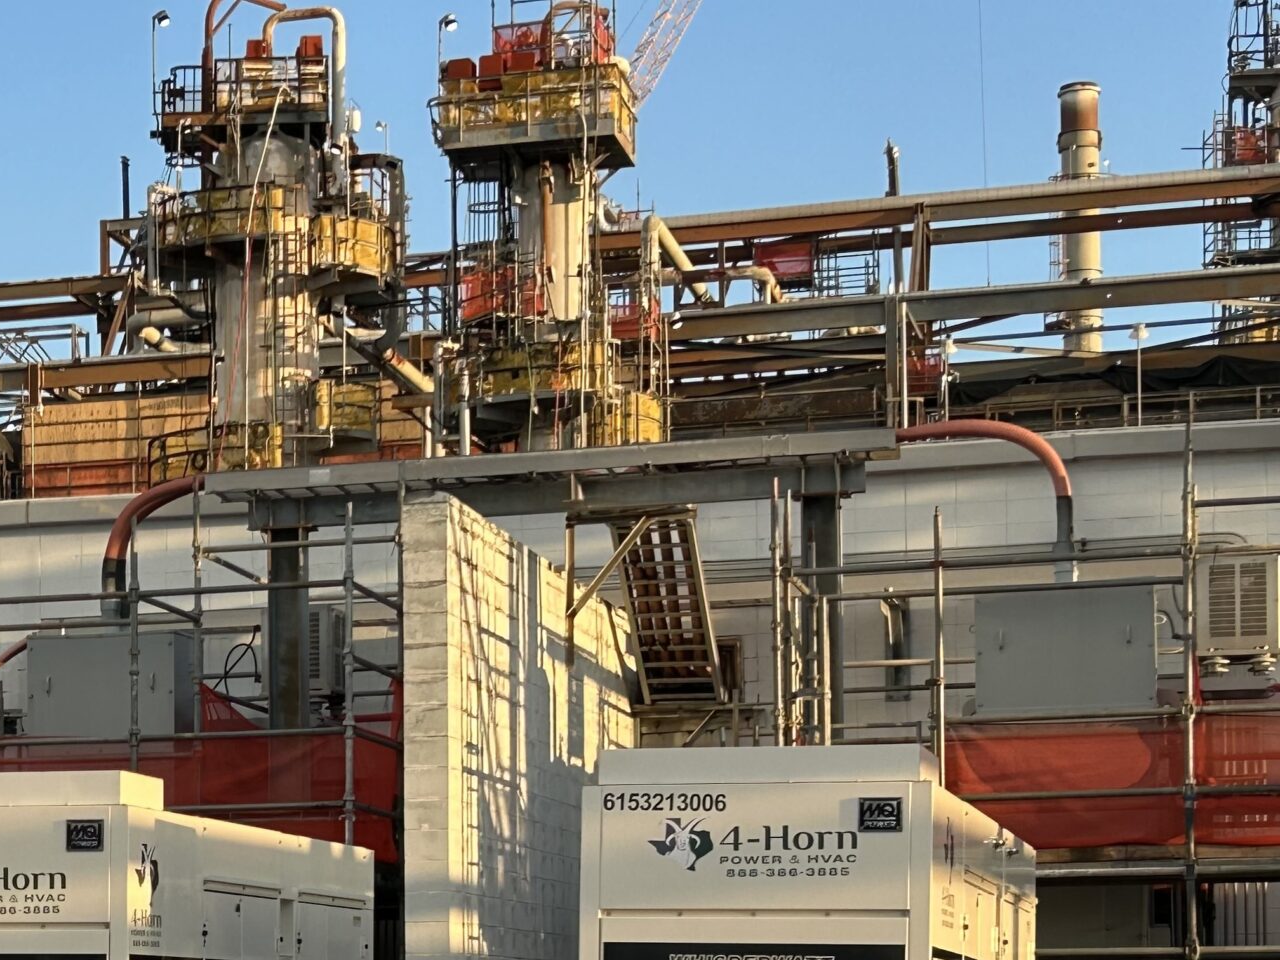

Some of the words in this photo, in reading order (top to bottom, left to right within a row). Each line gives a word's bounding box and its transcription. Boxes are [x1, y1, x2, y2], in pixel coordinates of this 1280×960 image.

[602, 793, 727, 813] 6153213006
[863, 802, 897, 818] MQ
[719, 825, 858, 851] 4-Horn
[719, 855, 782, 865] POWER
[789, 855, 800, 864] &
[807, 854, 857, 864] HVAC
[8, 894, 18, 903] &
[24, 893, 66, 903] HVAC
